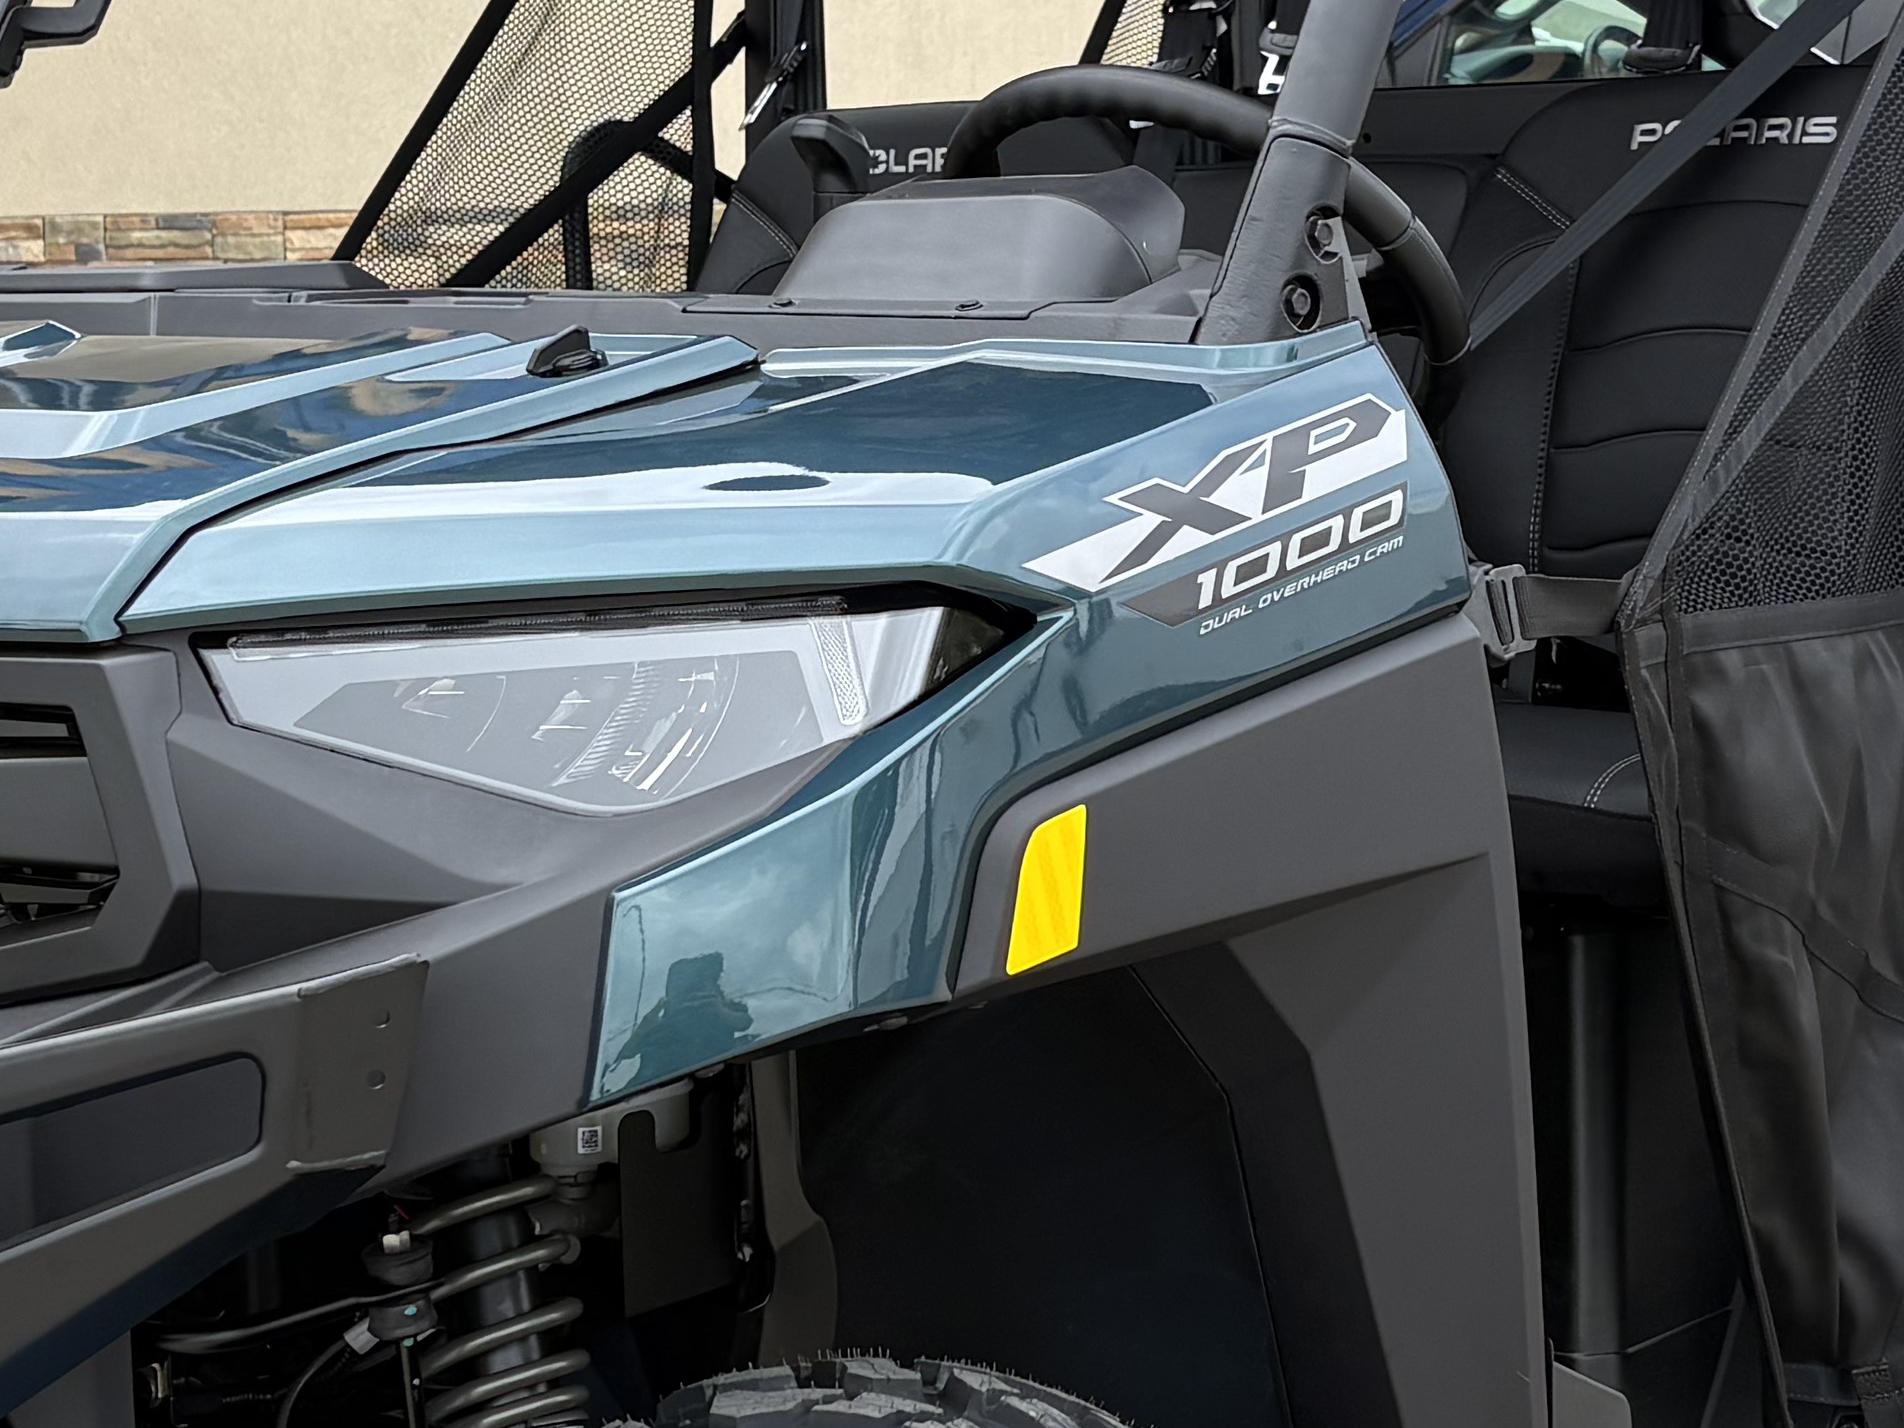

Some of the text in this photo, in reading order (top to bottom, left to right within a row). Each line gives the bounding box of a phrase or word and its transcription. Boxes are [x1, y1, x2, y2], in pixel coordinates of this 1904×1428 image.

[1630, 117, 1838, 150] PARIS
[1097, 394, 1405, 585] XP
[1197, 486, 1404, 611] 1000
[1199, 535, 1405, 636] DUAL OVERHEAD CAM
